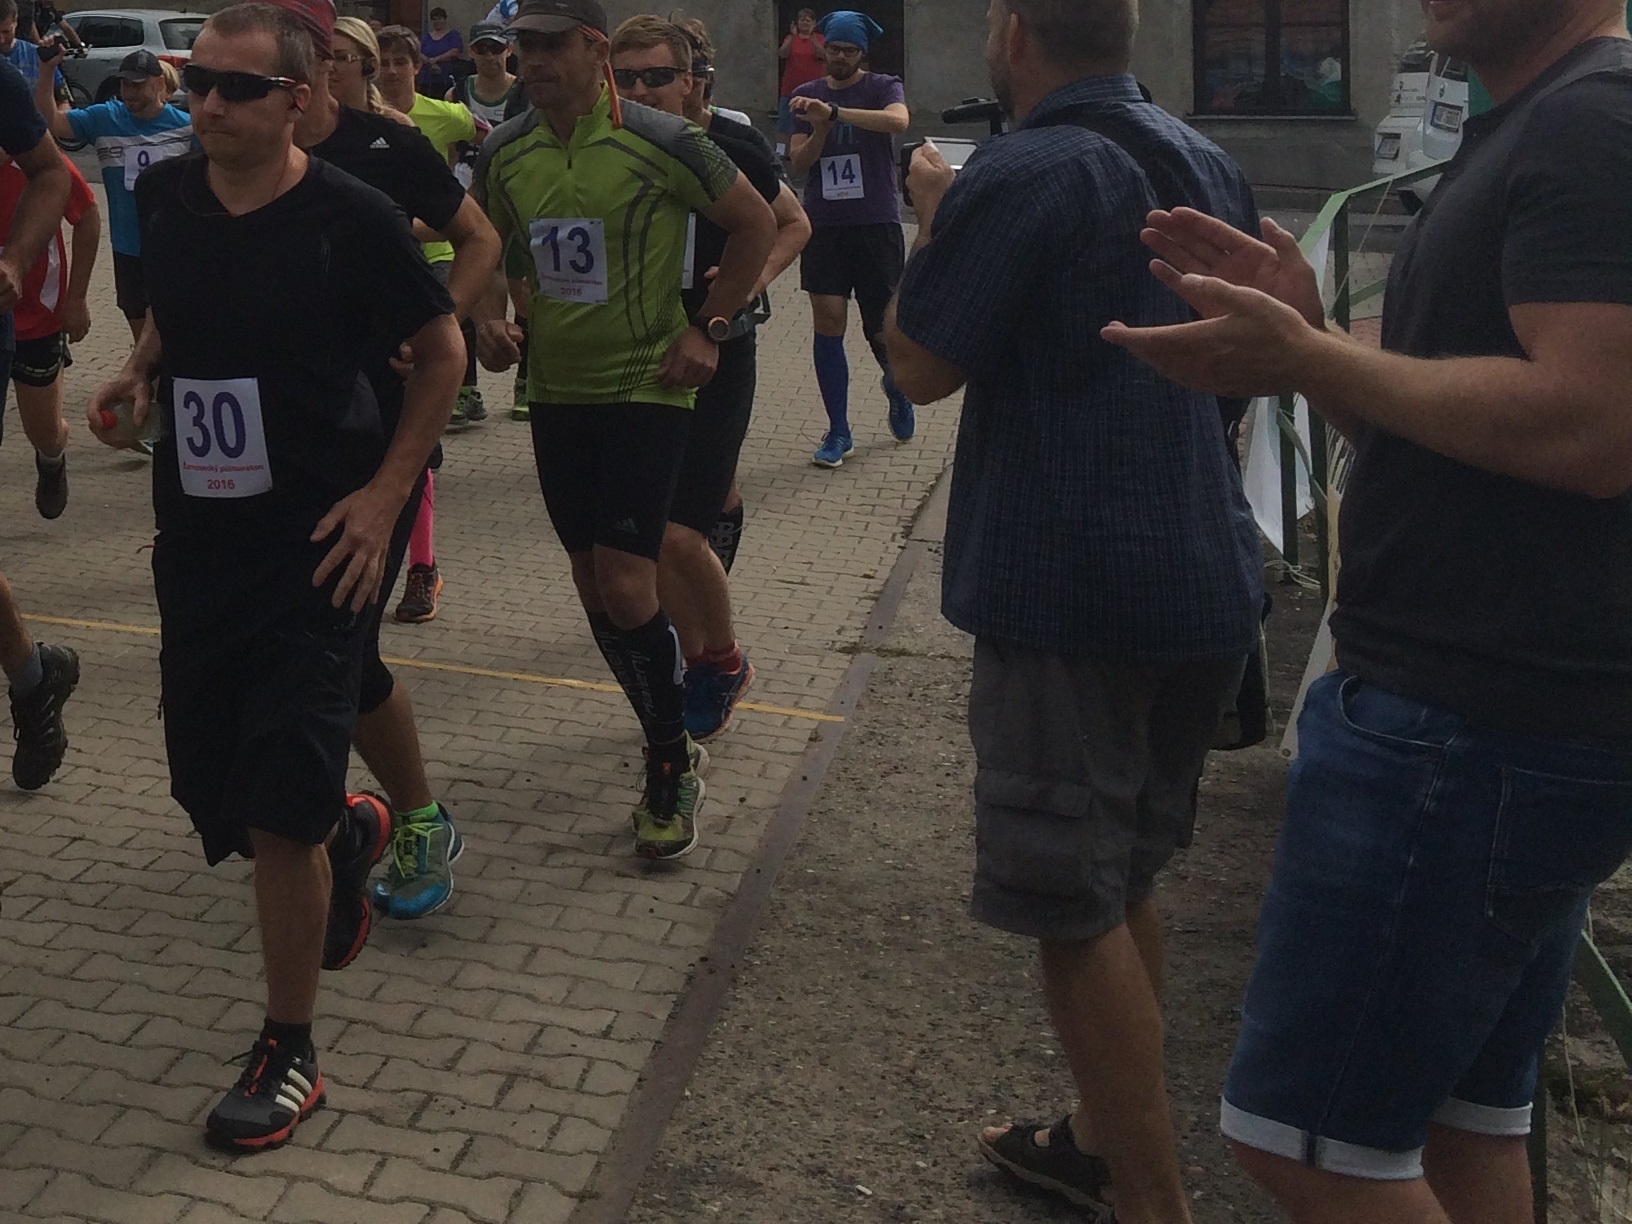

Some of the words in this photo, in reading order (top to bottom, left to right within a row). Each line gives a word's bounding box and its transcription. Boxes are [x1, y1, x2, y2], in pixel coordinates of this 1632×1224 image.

[827, 158, 856, 186] 14
[541, 226, 595, 275] 13
[183, 390, 246, 459] 30
[207, 479, 236, 490] 2016
